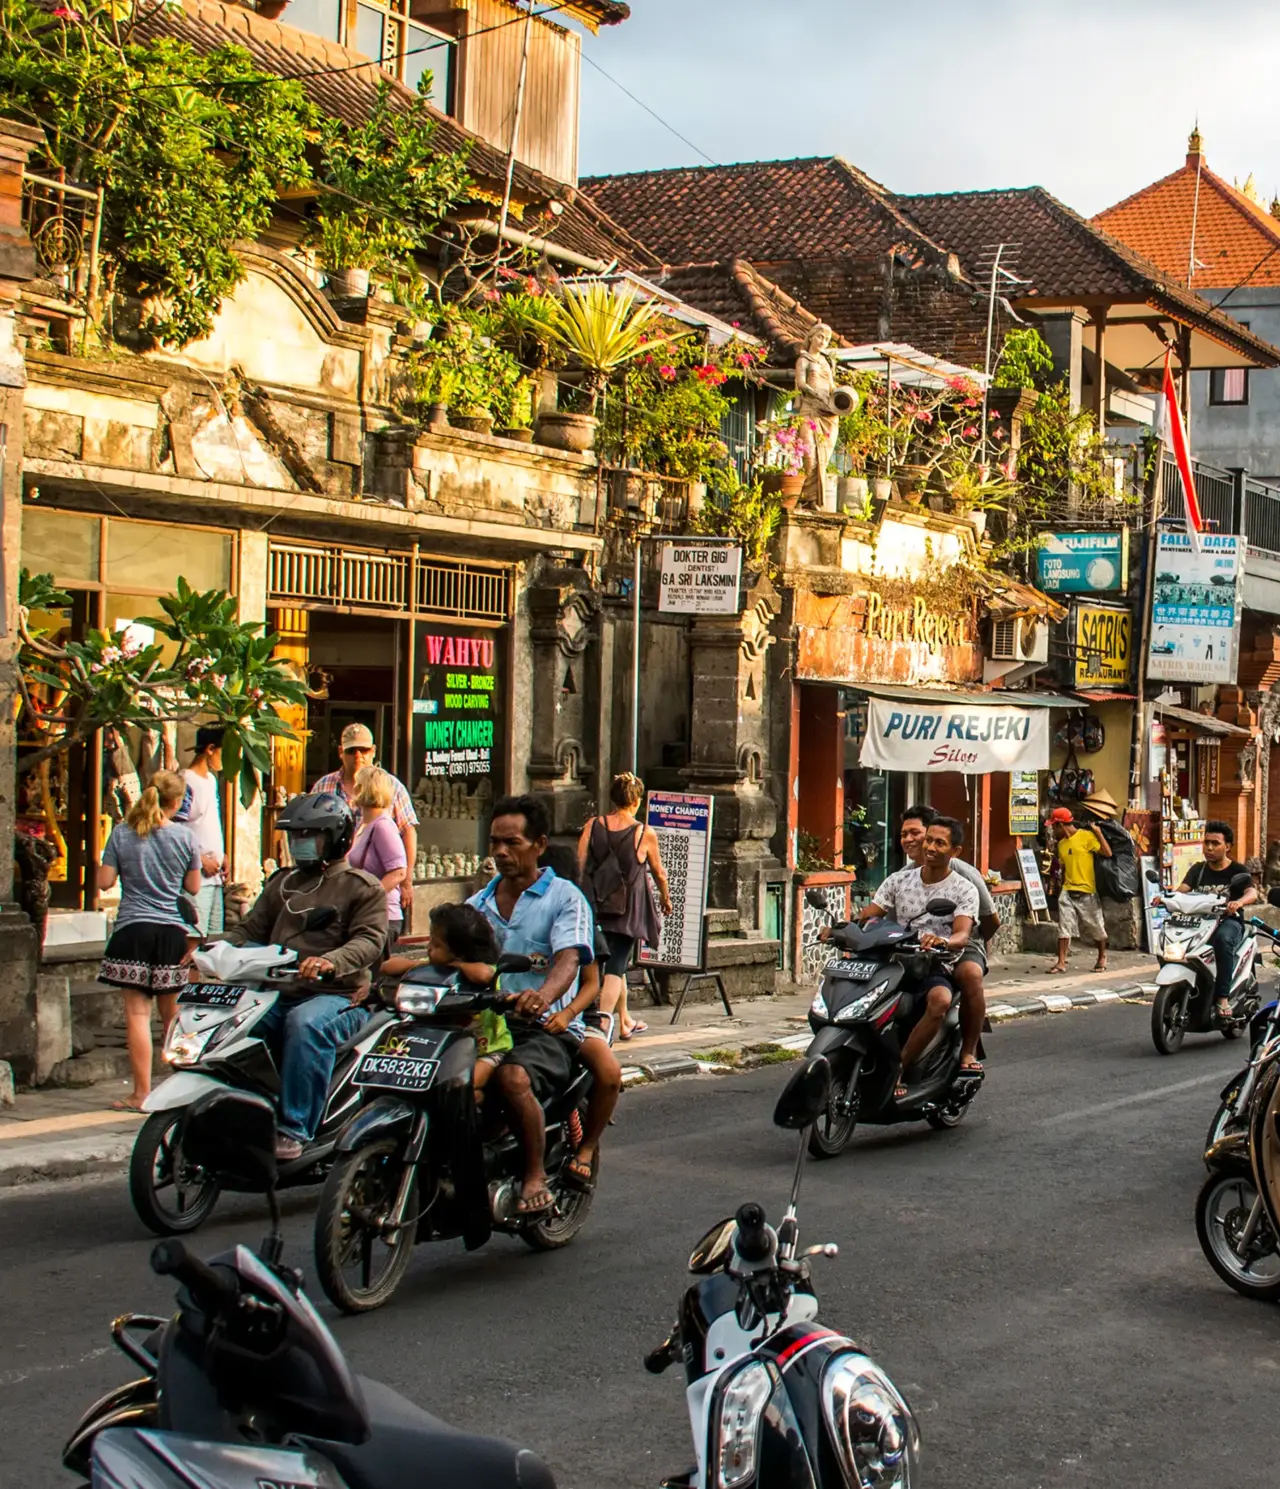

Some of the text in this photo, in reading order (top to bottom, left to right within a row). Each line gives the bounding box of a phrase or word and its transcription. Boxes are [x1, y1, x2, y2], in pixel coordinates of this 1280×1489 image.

[1062, 536, 1119, 549] FUJIFILM
[1161, 533, 1236, 547] FALU DAFA
[674, 550, 728, 563] DOKTER GIGI
[1044, 558, 1062, 569] FOTO
[1044, 569, 1080, 579] LANGSUNG
[678, 573, 692, 585] SRI
[695, 574, 737, 587] LAKSMINI
[1044, 579, 1060, 589] JADI
[867, 592, 965, 655] Puri Rejeki
[426, 635, 494, 668] WAHYU
[1080, 667, 1126, 679] RESTAURANT
[446, 673, 467, 689] SILVER
[471, 675, 494, 690] BRONZE
[445, 694, 489, 709] WOOD CARVING
[884, 712, 1031, 741] PURI REJEKI
[425, 720, 494, 749] MONEY CHANGER
[928, 744, 978, 765] Silver
[425, 763, 446, 776] Phone
[650, 804, 708, 817] MONEY CHANGER
[666, 834, 689, 844] 13650
[665, 843, 689, 853] 13600
[665, 851, 688, 861] 13500
[665, 860, 688, 869] 15150
[668, 869, 688, 878] 9800
[664, 920, 684, 929] 9650
[663, 929, 683, 938] 3050
[662, 938, 682, 946] 1700
[666, 946, 681, 955] 300
[662, 954, 681, 964] 2050
[840, 961, 864, 971] 3412
